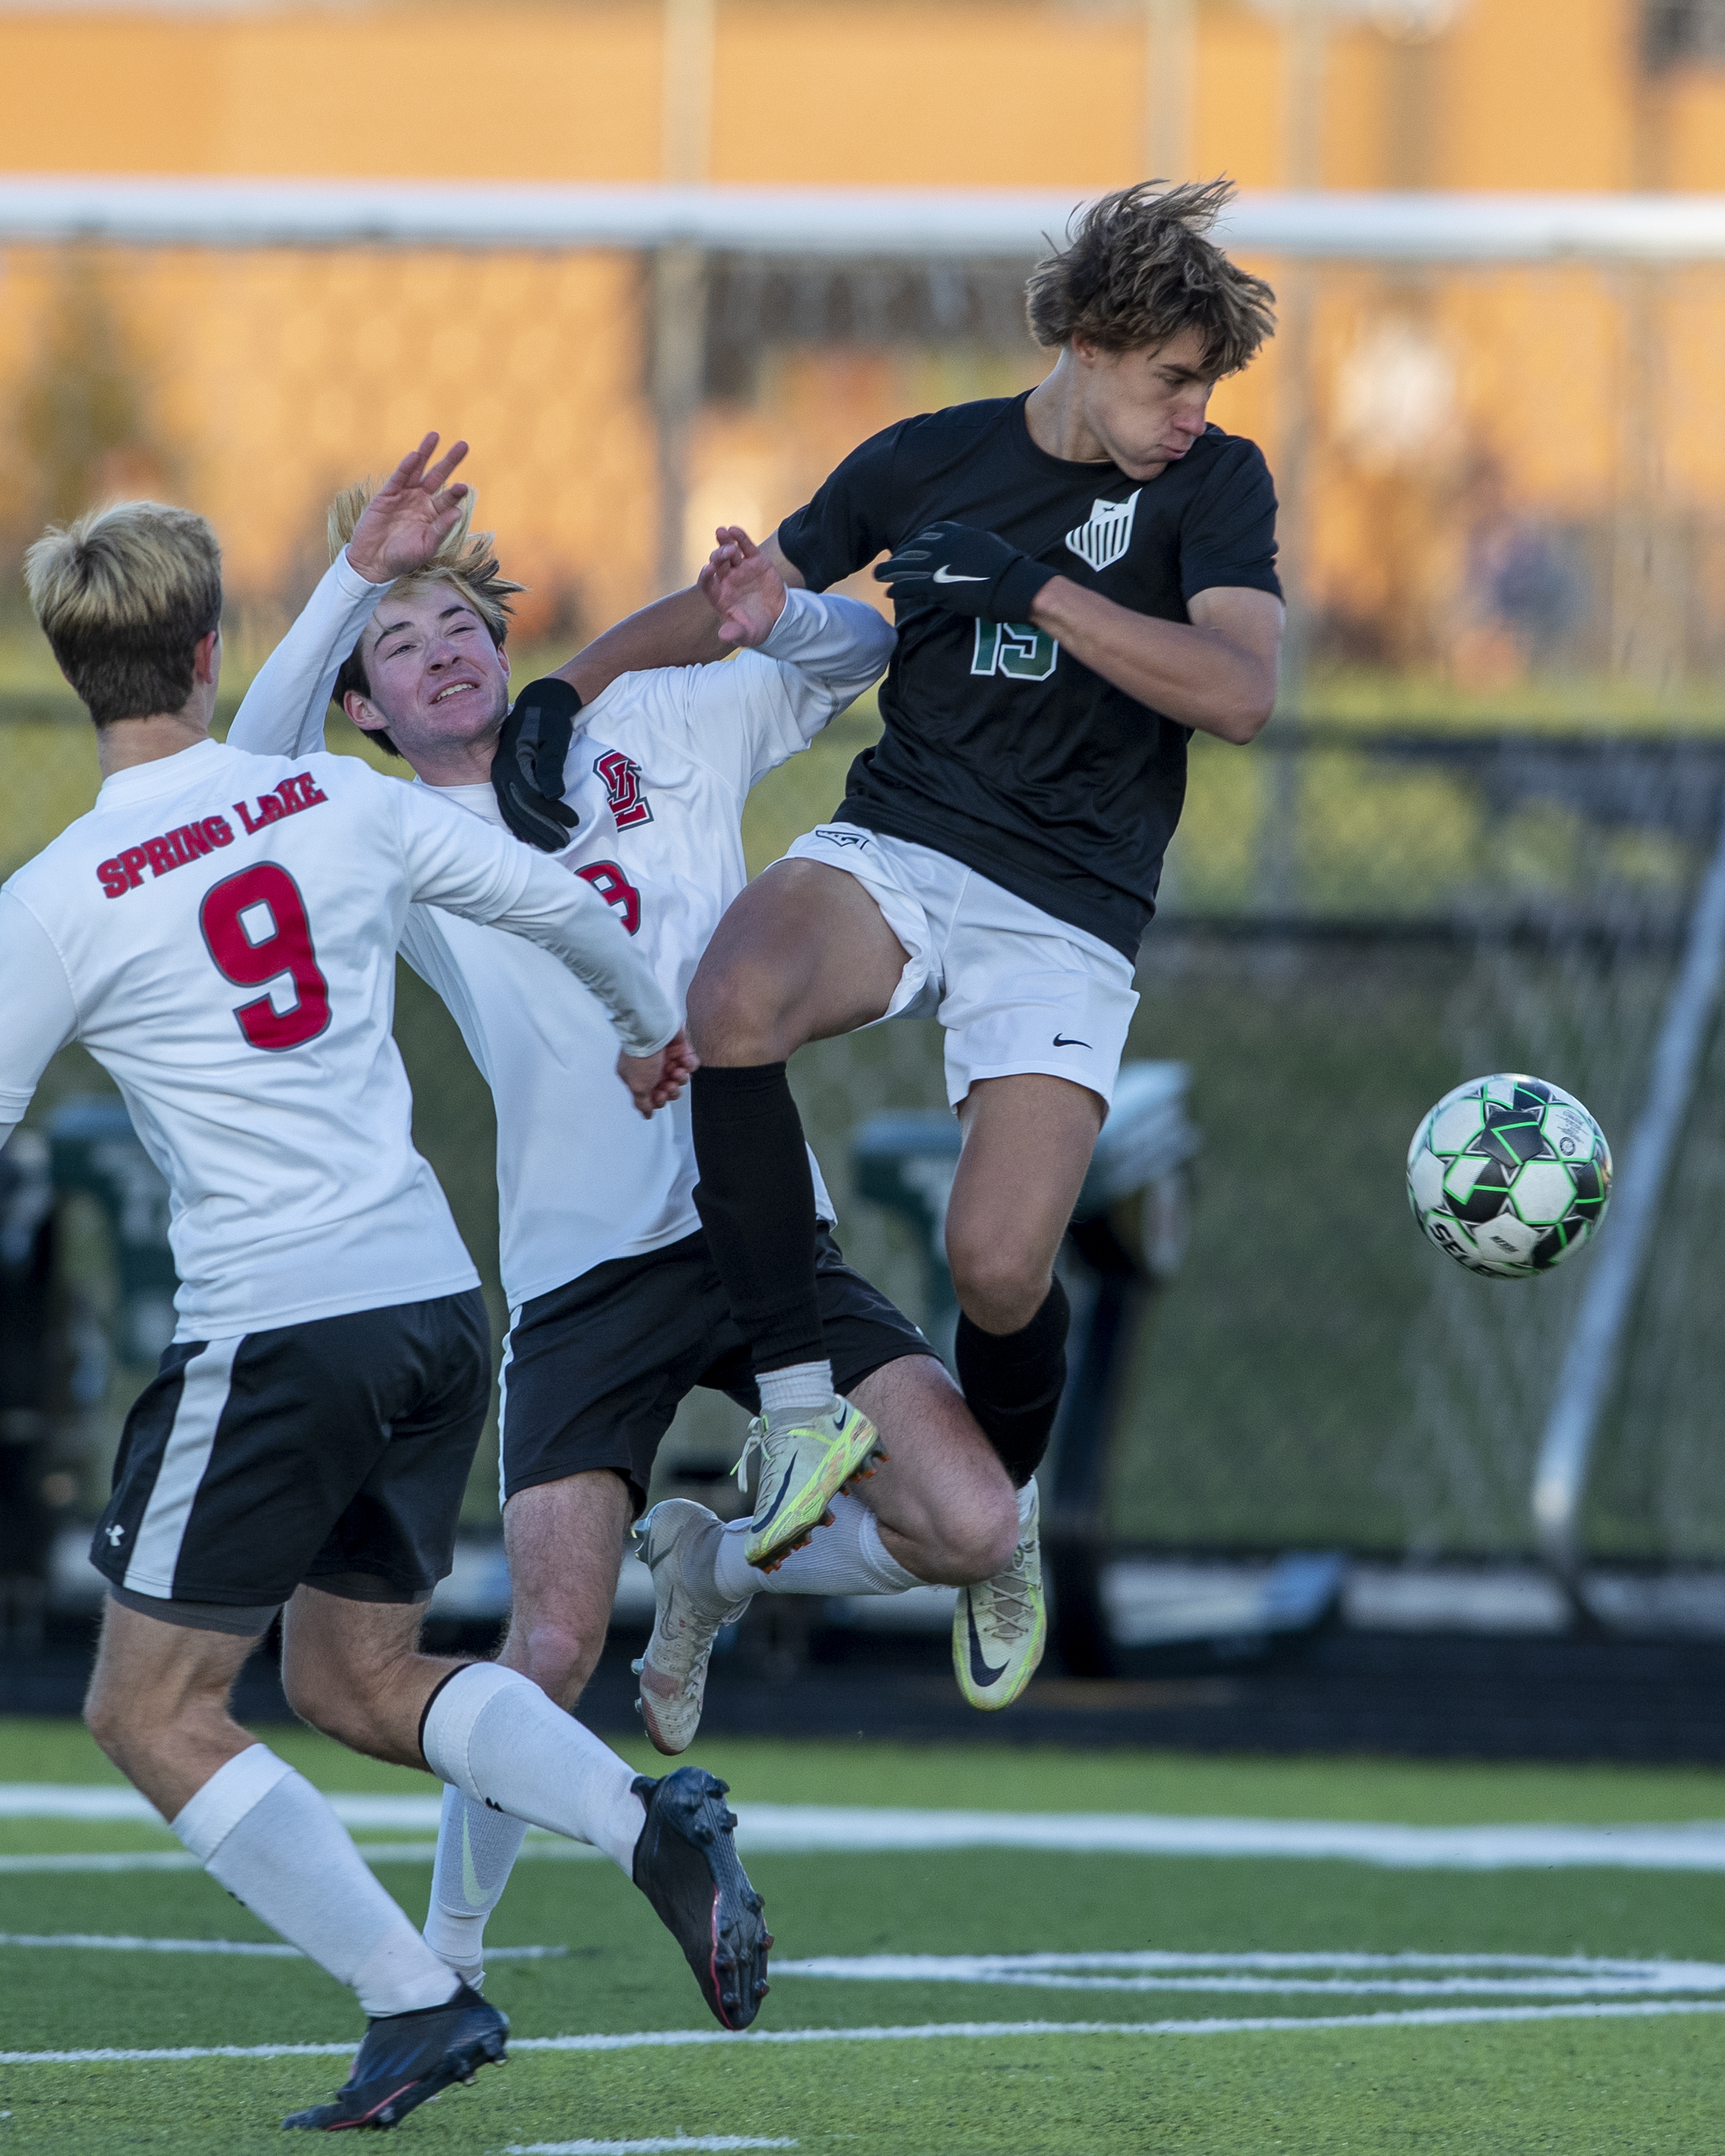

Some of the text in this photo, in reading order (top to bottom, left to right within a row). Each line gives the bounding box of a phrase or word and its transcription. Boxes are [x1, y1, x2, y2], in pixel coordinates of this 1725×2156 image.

[96, 771, 329, 899] SPRING LAKE
[199, 860, 333, 1053] 9
